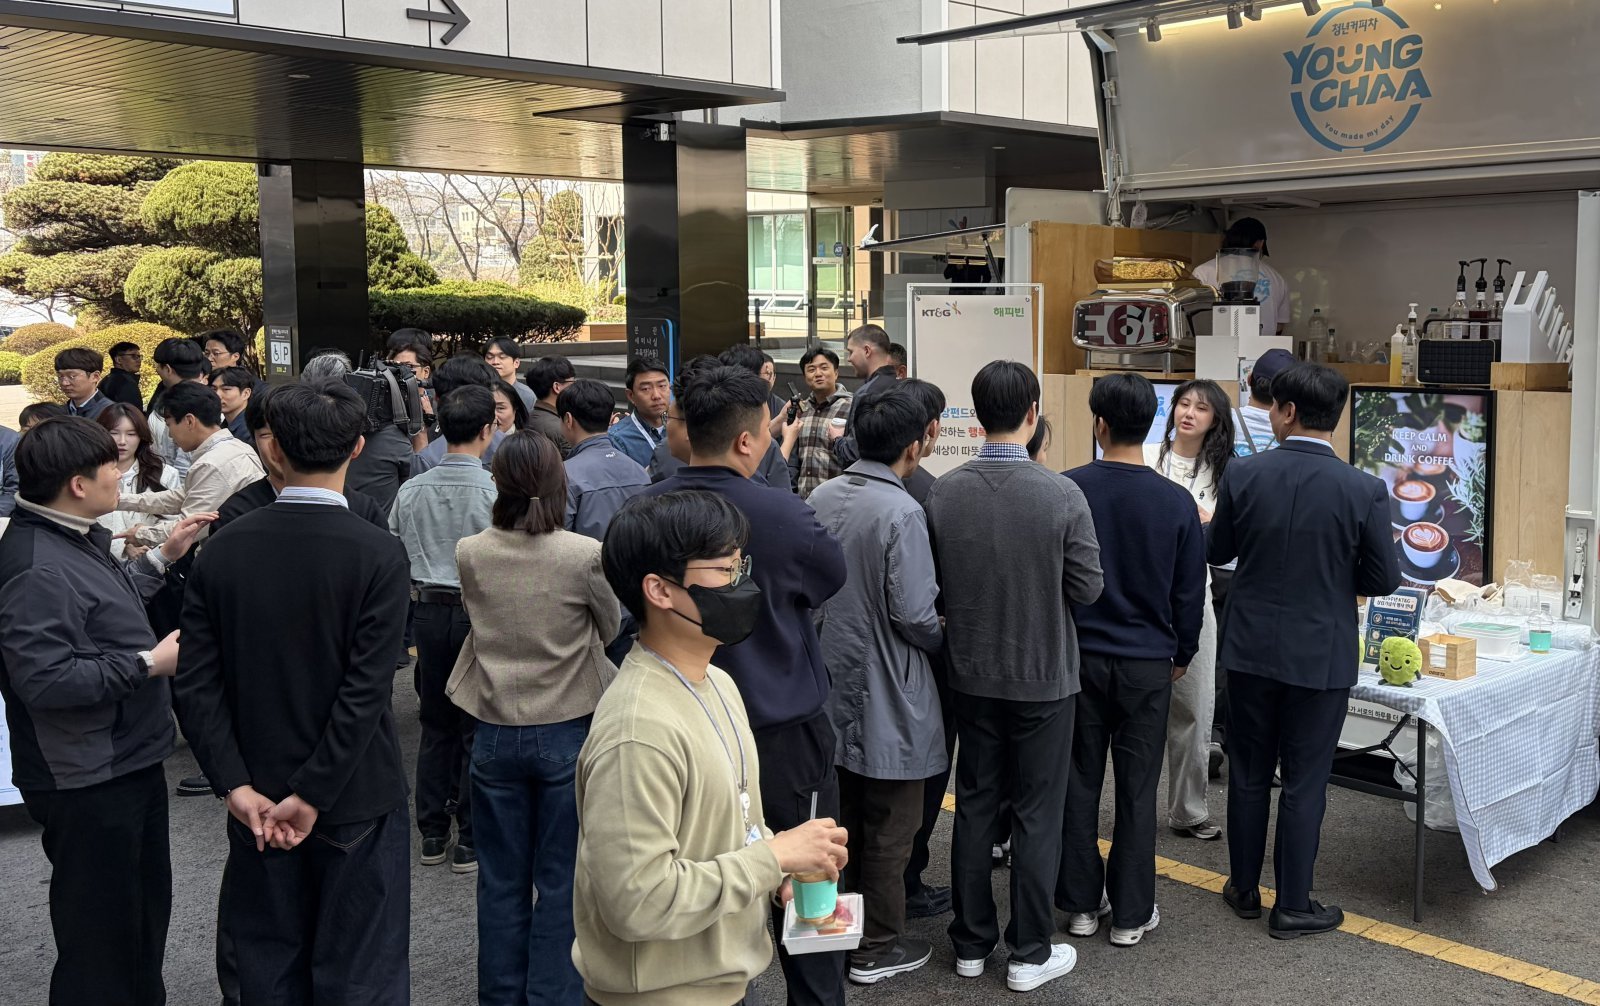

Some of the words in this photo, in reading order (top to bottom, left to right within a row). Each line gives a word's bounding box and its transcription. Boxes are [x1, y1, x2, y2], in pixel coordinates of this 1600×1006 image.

[1331, 17, 1379, 36] 청년커피차
[1283, 34, 1423, 84] YOUNG
[1309, 68, 1433, 112] CHAA
[1325, 122, 1339, 135] You
[1340, 132, 1364, 140] made
[1366, 128, 1378, 138] my
[921, 308, 952, 318] KT&G
[993, 306, 1025, 318] 해피빈
[1392, 430, 1416, 441] KEEP
[1418, 431, 1447, 442] CALM
[931, 445, 959, 456] 세상이
[1411, 444, 1427, 452] AND
[1384, 452, 1416, 464] DRINK
[1417, 455, 1455, 466] COFFEE
